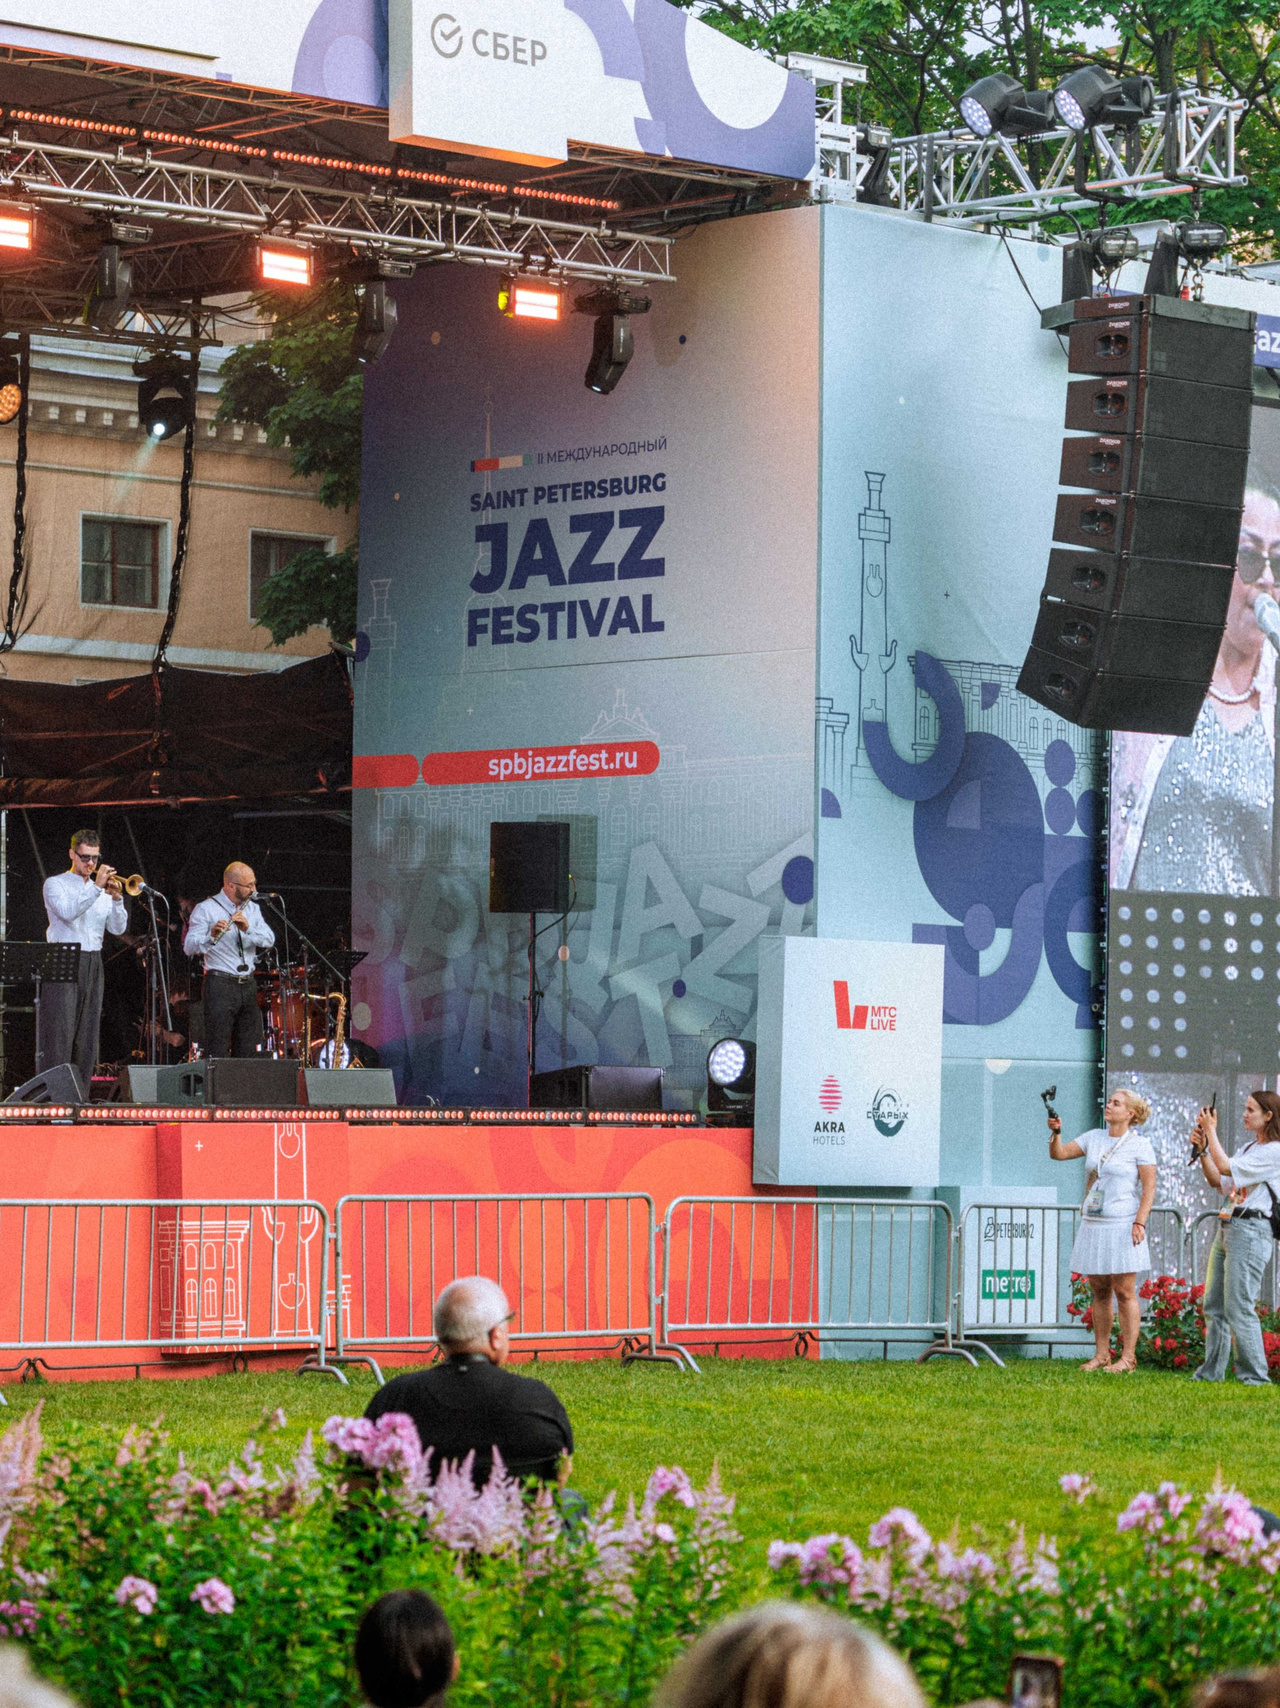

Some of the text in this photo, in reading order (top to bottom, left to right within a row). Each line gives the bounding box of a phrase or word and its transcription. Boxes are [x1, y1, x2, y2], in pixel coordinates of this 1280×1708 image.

[472, 28, 548, 67] СБЕР
[547, 436, 668, 464] МЕЖДУНАРОДНЫЙ
[470, 472, 667, 512] SAINT PETERSBURG
[469, 505, 665, 594] JAZZ
[467, 594, 665, 648] FESTIVAL
[488, 749, 638, 780] spbjazzfest.ru
[870, 1019, 896, 1031] LIVE
[813, 1136, 846, 1146] HOTELS
[814, 1121, 845, 1133] AKRA
